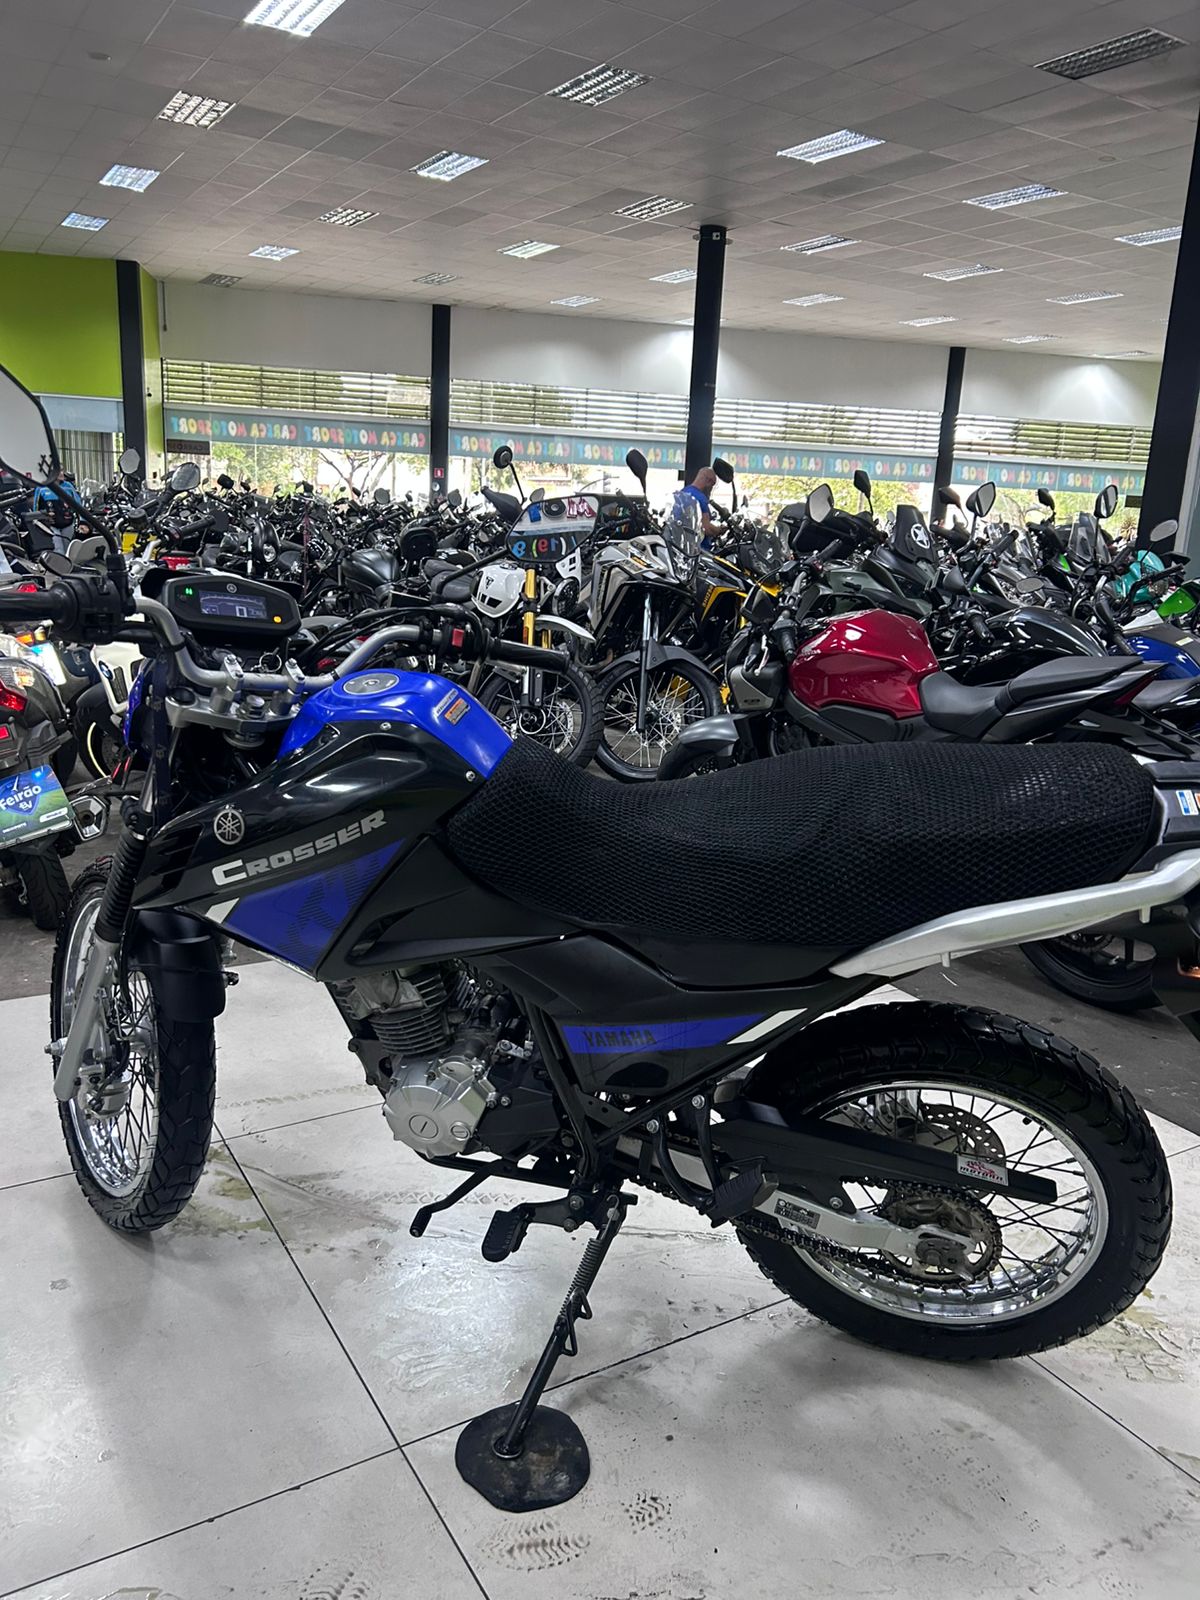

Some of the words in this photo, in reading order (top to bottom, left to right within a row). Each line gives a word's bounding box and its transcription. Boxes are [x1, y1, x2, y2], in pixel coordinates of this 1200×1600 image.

[0, 785, 42, 811] Feirão
[211, 809, 387, 886] CROSSER
[582, 1029, 657, 1048] YAMAHA
